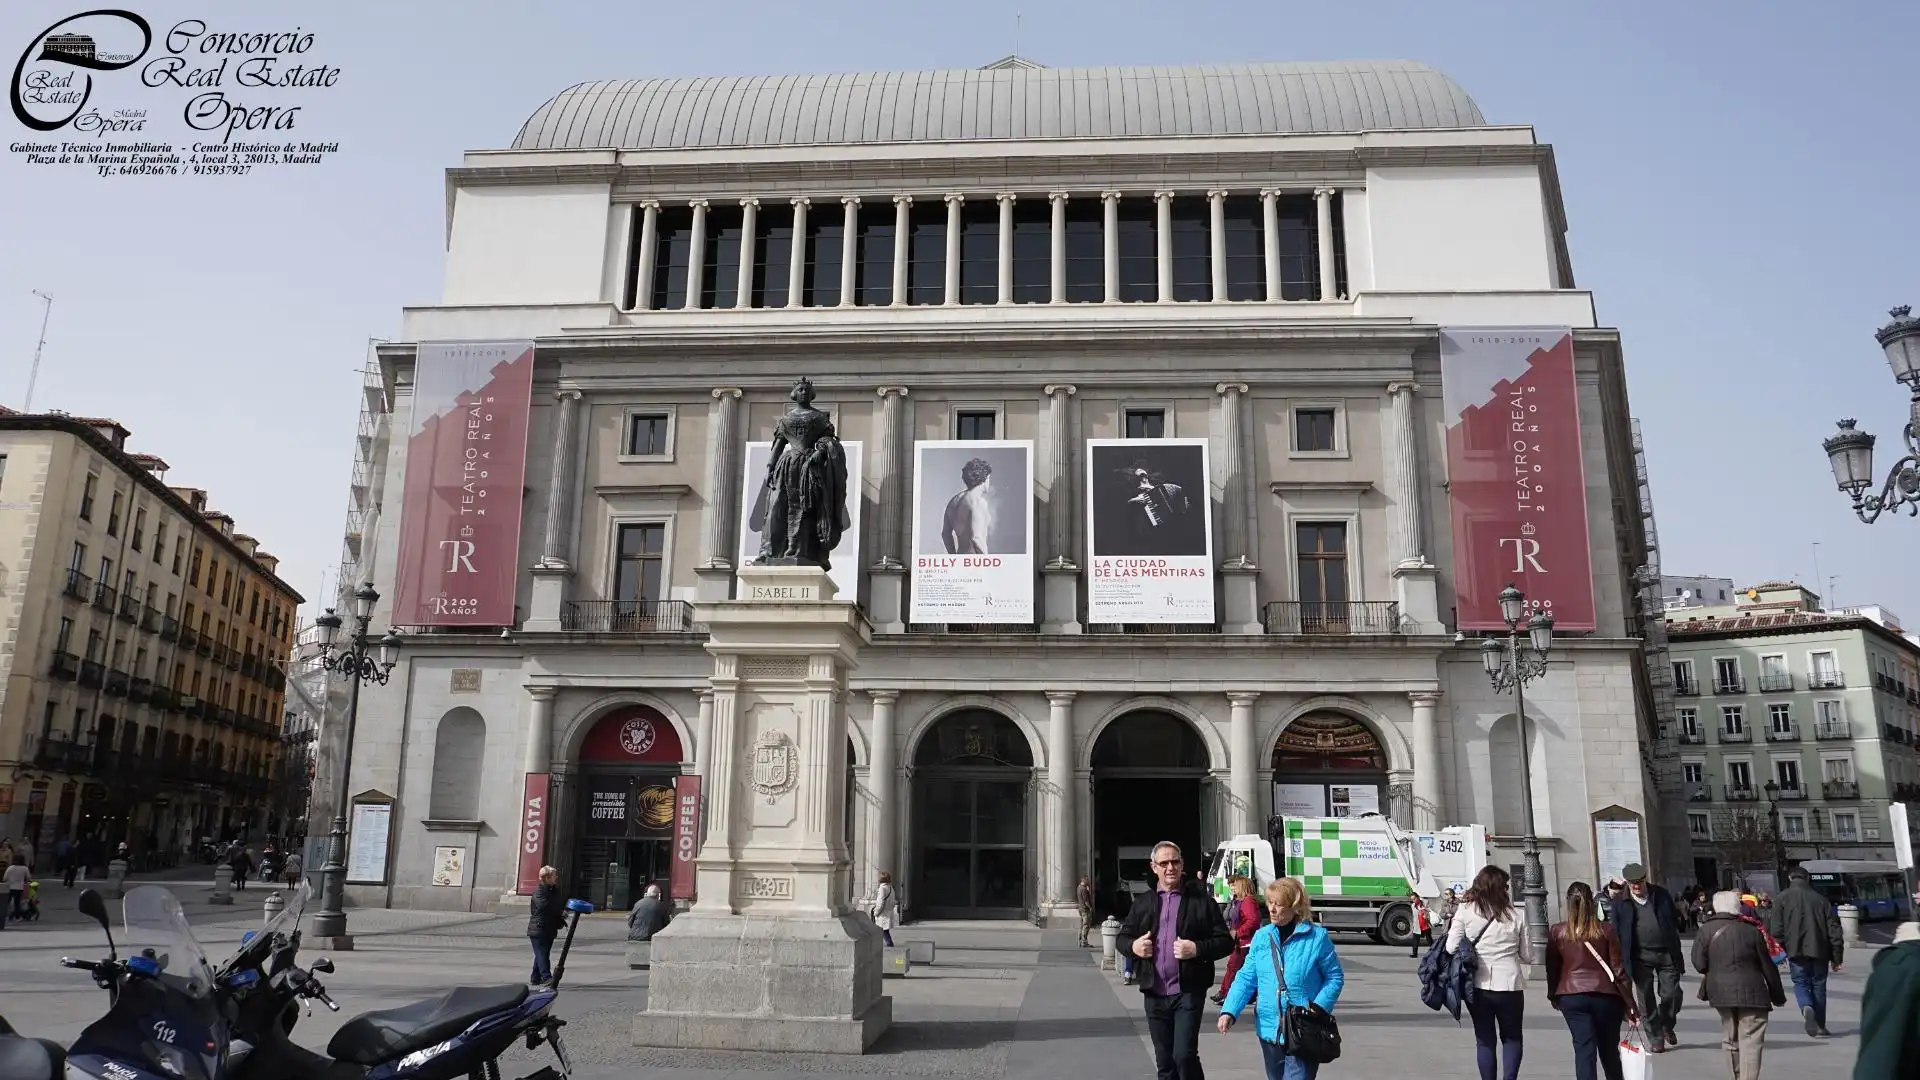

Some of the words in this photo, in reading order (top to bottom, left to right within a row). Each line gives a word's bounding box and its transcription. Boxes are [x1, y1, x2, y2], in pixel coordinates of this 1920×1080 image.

[1510, 386, 1525, 432] REAL
[467, 397, 482, 440] REAL
[1527, 386, 1541, 452] AÑOS
[482, 396, 495, 459] AÑOS
[461, 447, 478, 515] TEATRO
[1513, 440, 1531, 511] TEATRO
[478, 470, 488, 516] 200
[1534, 464, 1545, 512] 200
[918, 558, 957, 567] BILLY
[963, 558, 1002, 567] BUDD
[1094, 559, 1111, 568] LA
[1116, 559, 1167, 568] CIUDAD
[1094, 568, 1111, 577] DE
[1114, 568, 1138, 577] LAS
[1141, 568, 1206, 577] MENTIRAS
[752, 586, 797, 598] ISABEL
[801, 587, 810, 598] II
[451, 598, 478, 606] 200
[450, 606, 477, 615] AÑOS
[1524, 608, 1553, 617] AS
[626, 721, 649, 731] COSTA
[624, 739, 651, 752] COFFEE
[592, 807, 625, 819] COFFEE
[525, 796, 542, 854] COSTA
[678, 795, 696, 862] COFFEE
[1439, 840, 1463, 853] 3492
[1360, 852, 1390, 860] madrid
[157, 1025, 177, 1043] 112
